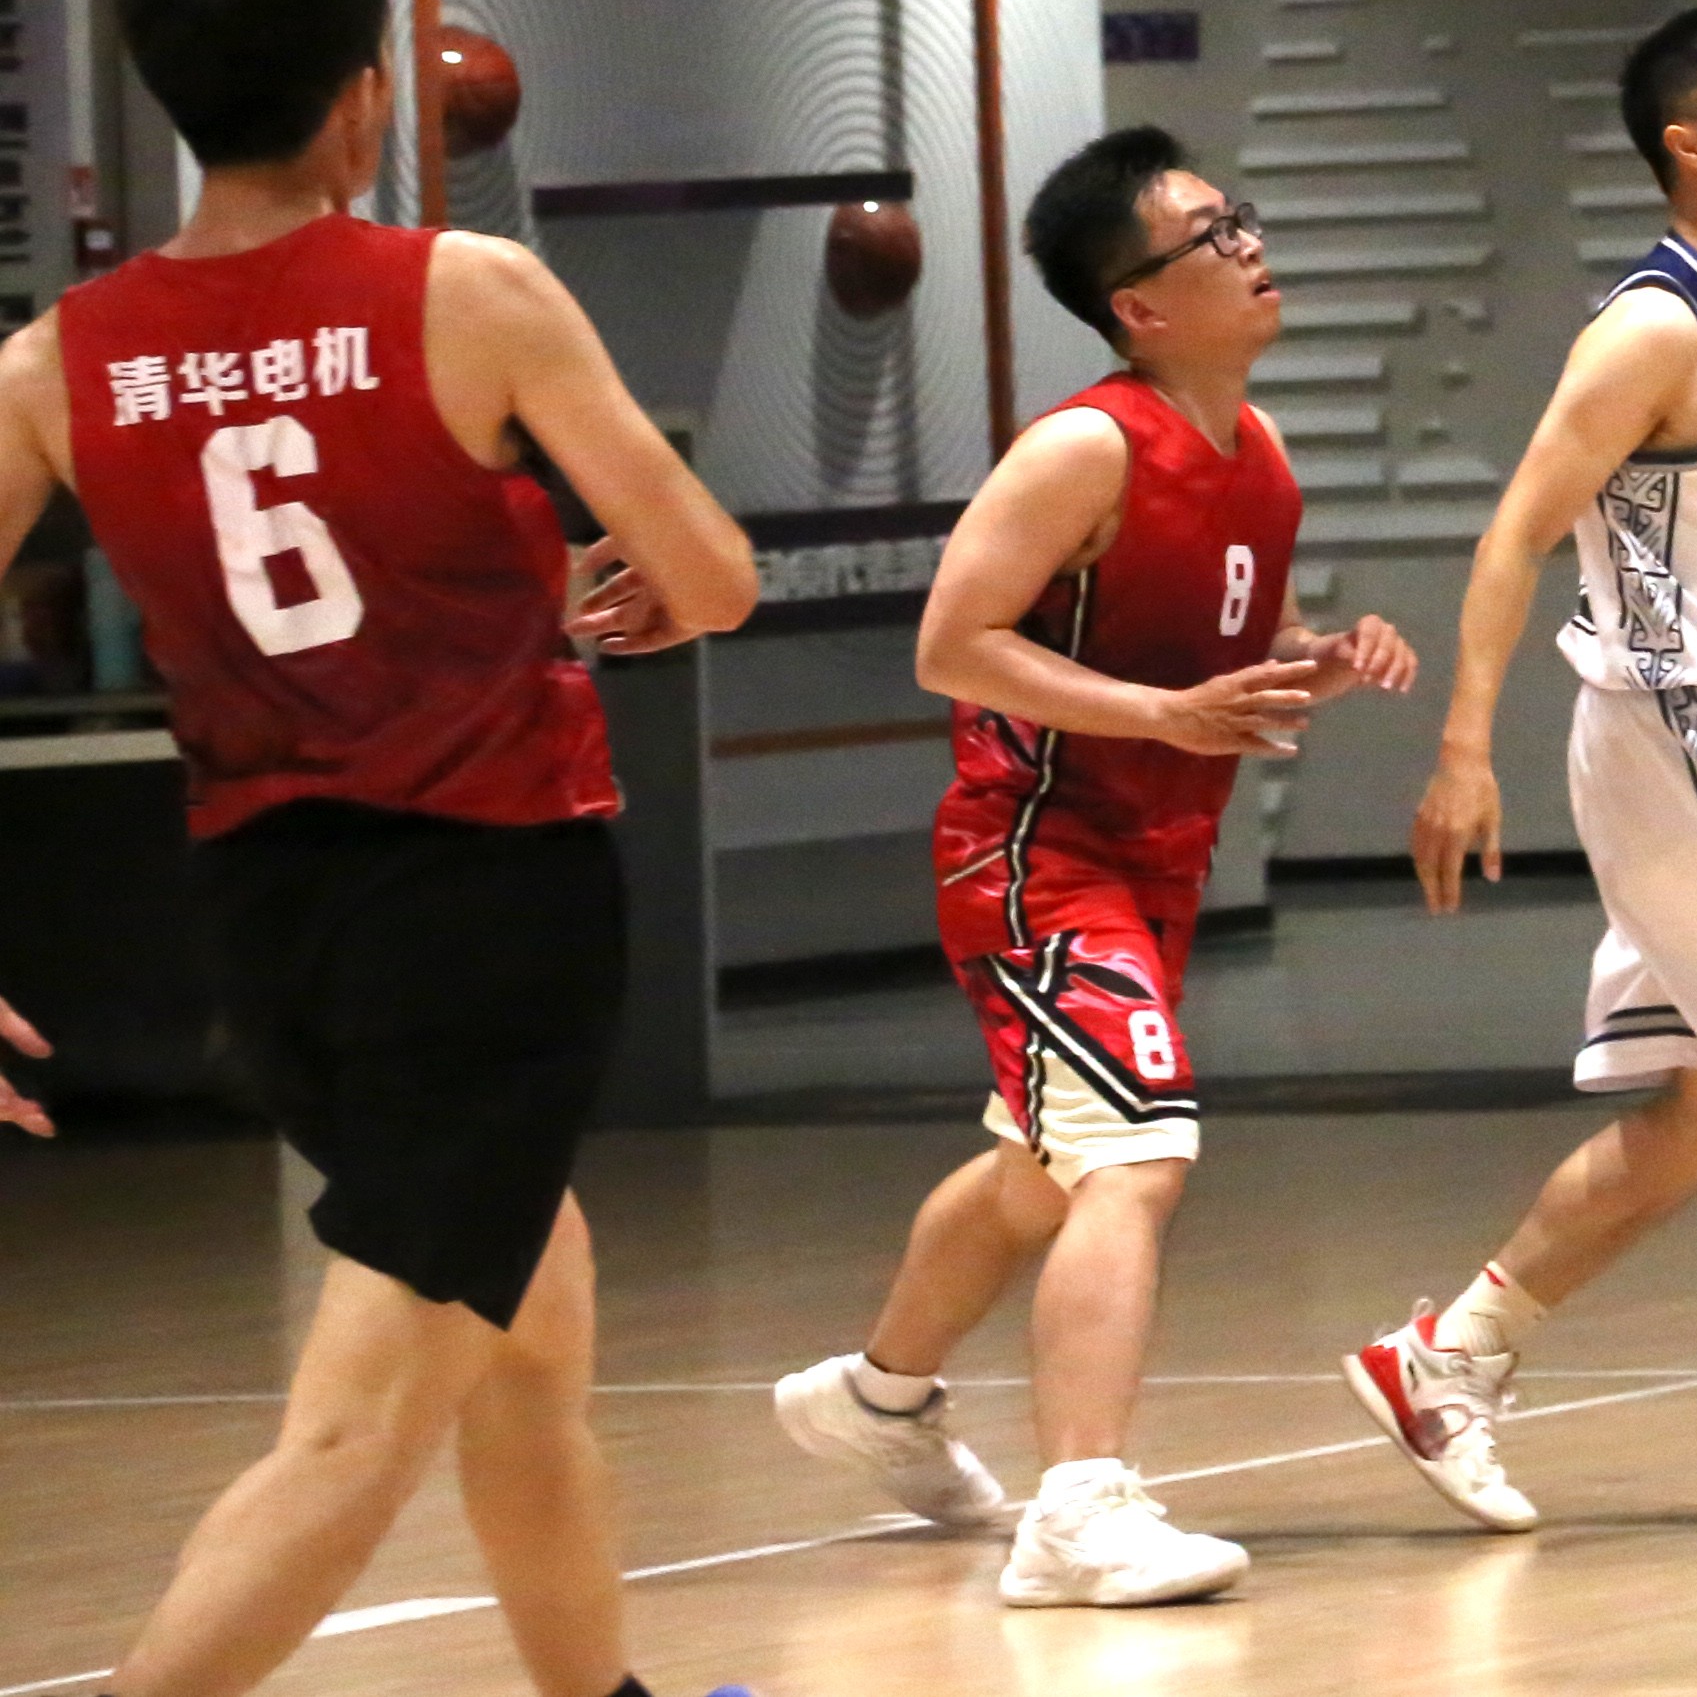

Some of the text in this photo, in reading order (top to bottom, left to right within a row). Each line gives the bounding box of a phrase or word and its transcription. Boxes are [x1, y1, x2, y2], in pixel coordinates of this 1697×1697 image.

[107, 326, 380, 426] 清华电机
[201, 415, 364, 657] 6
[1219, 544, 1254, 637] 8
[1127, 1009, 1176, 1080] 8
